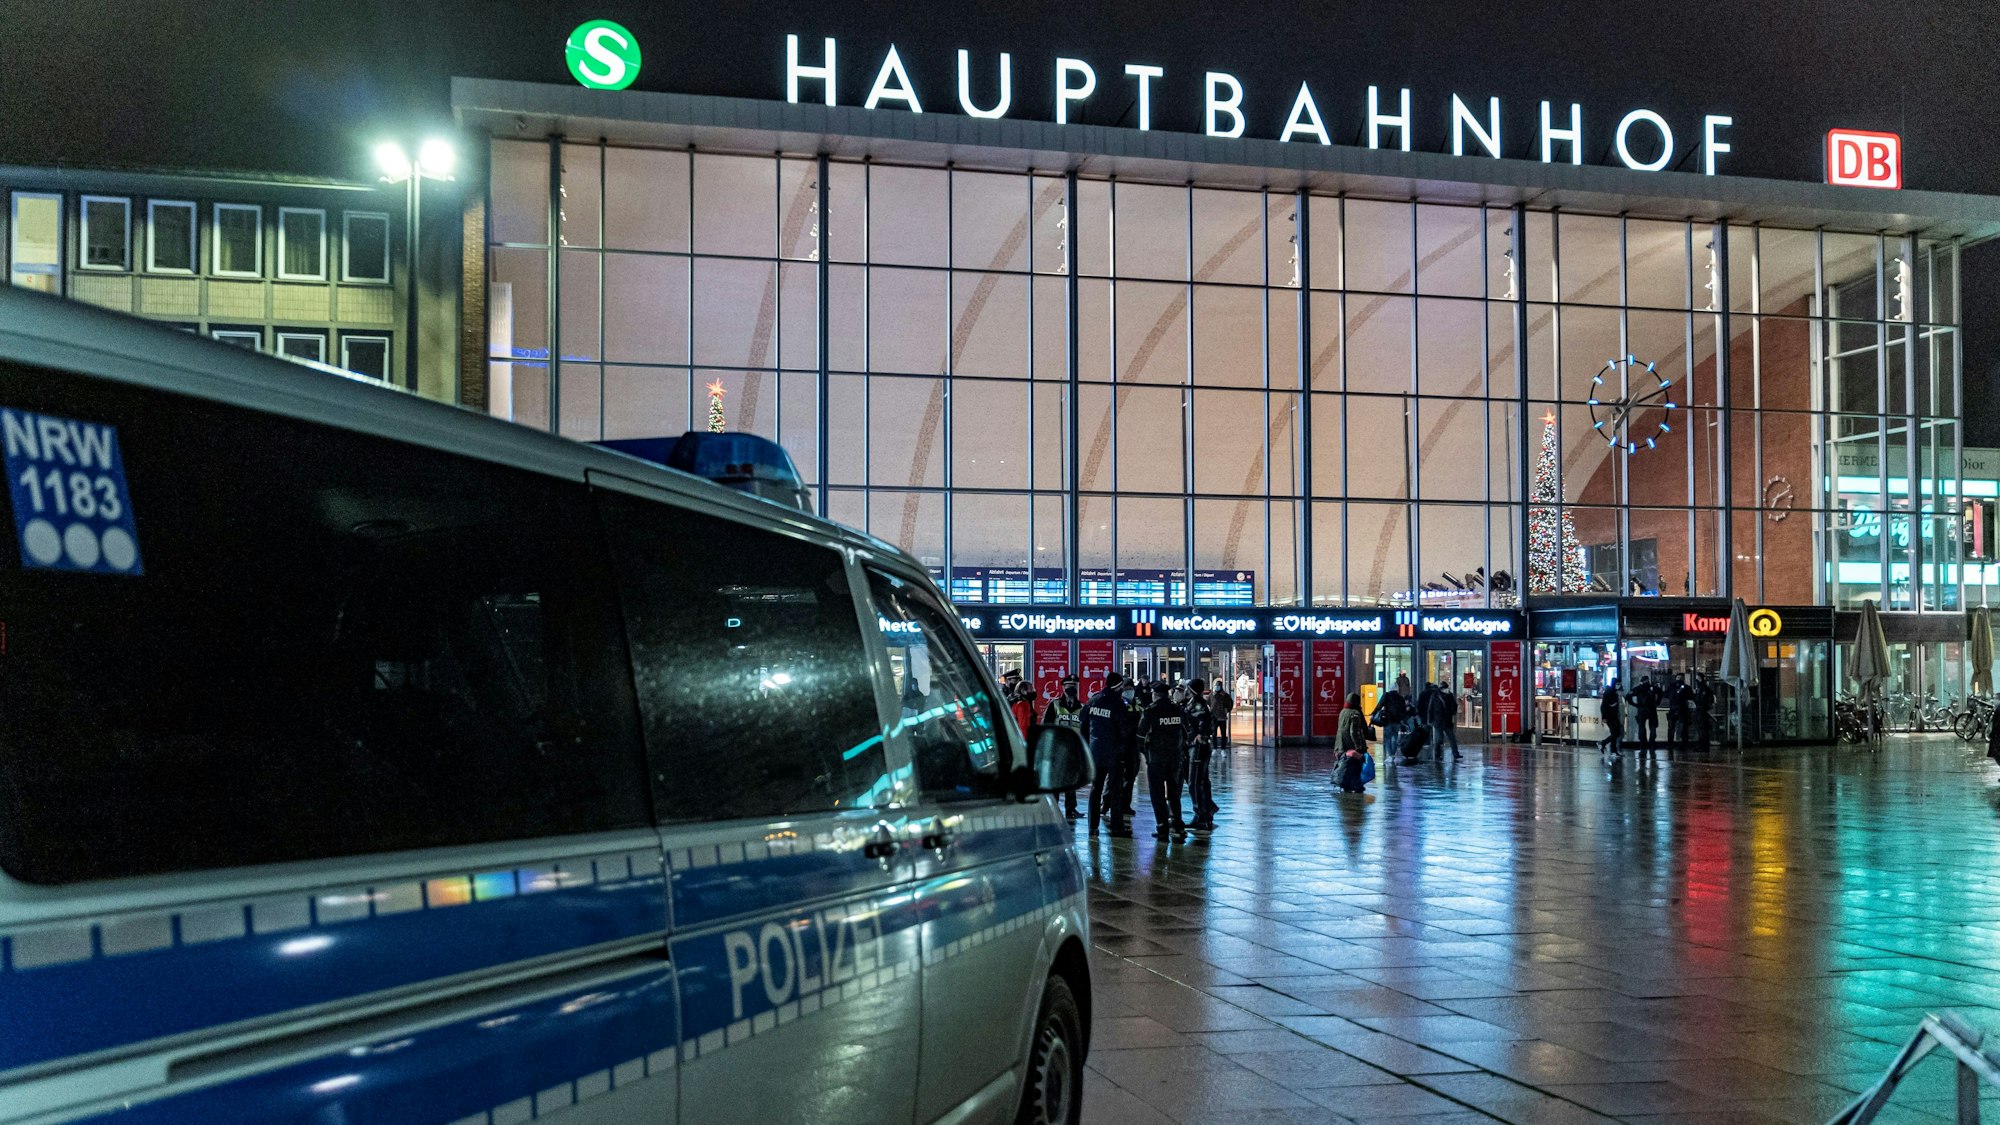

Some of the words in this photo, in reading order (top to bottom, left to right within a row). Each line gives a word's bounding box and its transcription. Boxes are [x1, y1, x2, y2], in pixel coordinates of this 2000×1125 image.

[579, 27, 628, 85] S
[786, 33, 1733, 176] HAUPTBAHNHOF
[1838, 139, 1892, 181] DB
[1, 407, 112, 470] NRW
[1839, 455, 1878, 467] ERME
[19, 464, 123, 521] 1183
[1029, 614, 1116, 635] Highspeed
[1161, 615, 1257, 635] NetCologne
[1300, 615, 1381, 635] Highspeed
[1423, 616, 1511, 636] NetCologne
[1683, 613, 1731, 632] Kam
[1058, 714, 1080, 722] POLIZ
[1089, 706, 1111, 718] POLIZEI
[1159, 716, 1181, 726] POLIZEI
[723, 901, 884, 1018] POLIZEI
